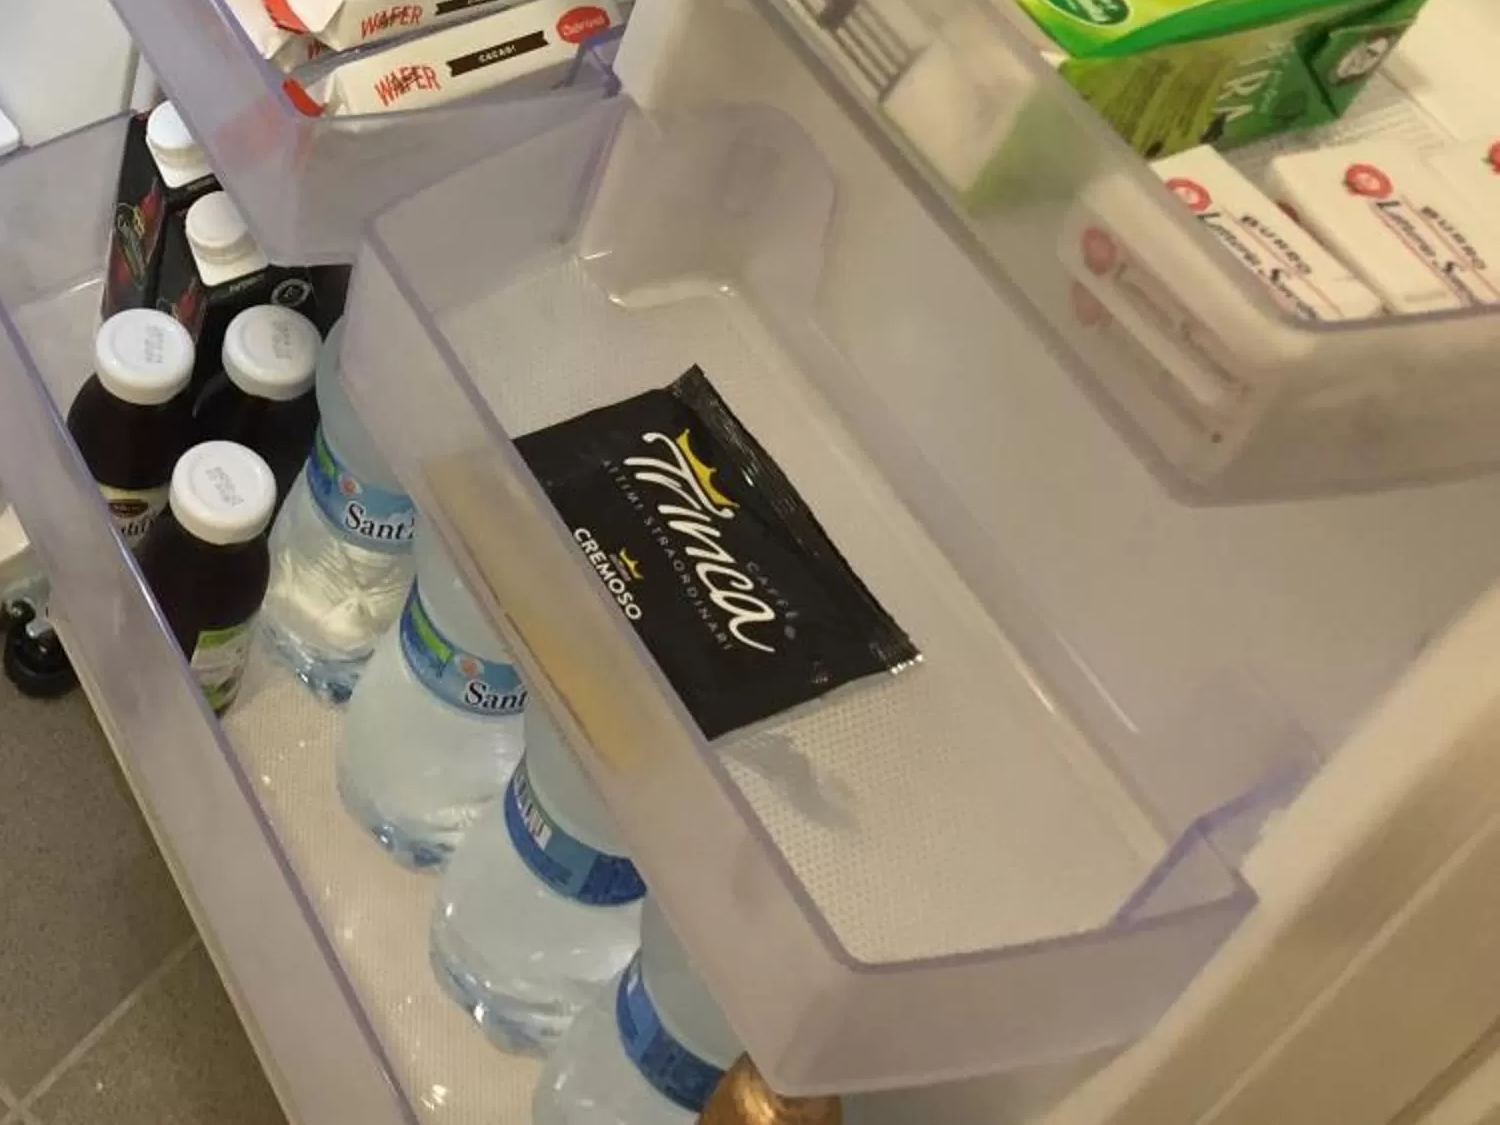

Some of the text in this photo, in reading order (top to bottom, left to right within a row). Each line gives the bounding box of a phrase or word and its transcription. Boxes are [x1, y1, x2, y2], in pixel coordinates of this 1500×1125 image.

[360, 4, 423, 40] WAFER
[373, 65, 442, 107] WAFER
[573, 526, 642, 621] CREMOSO
